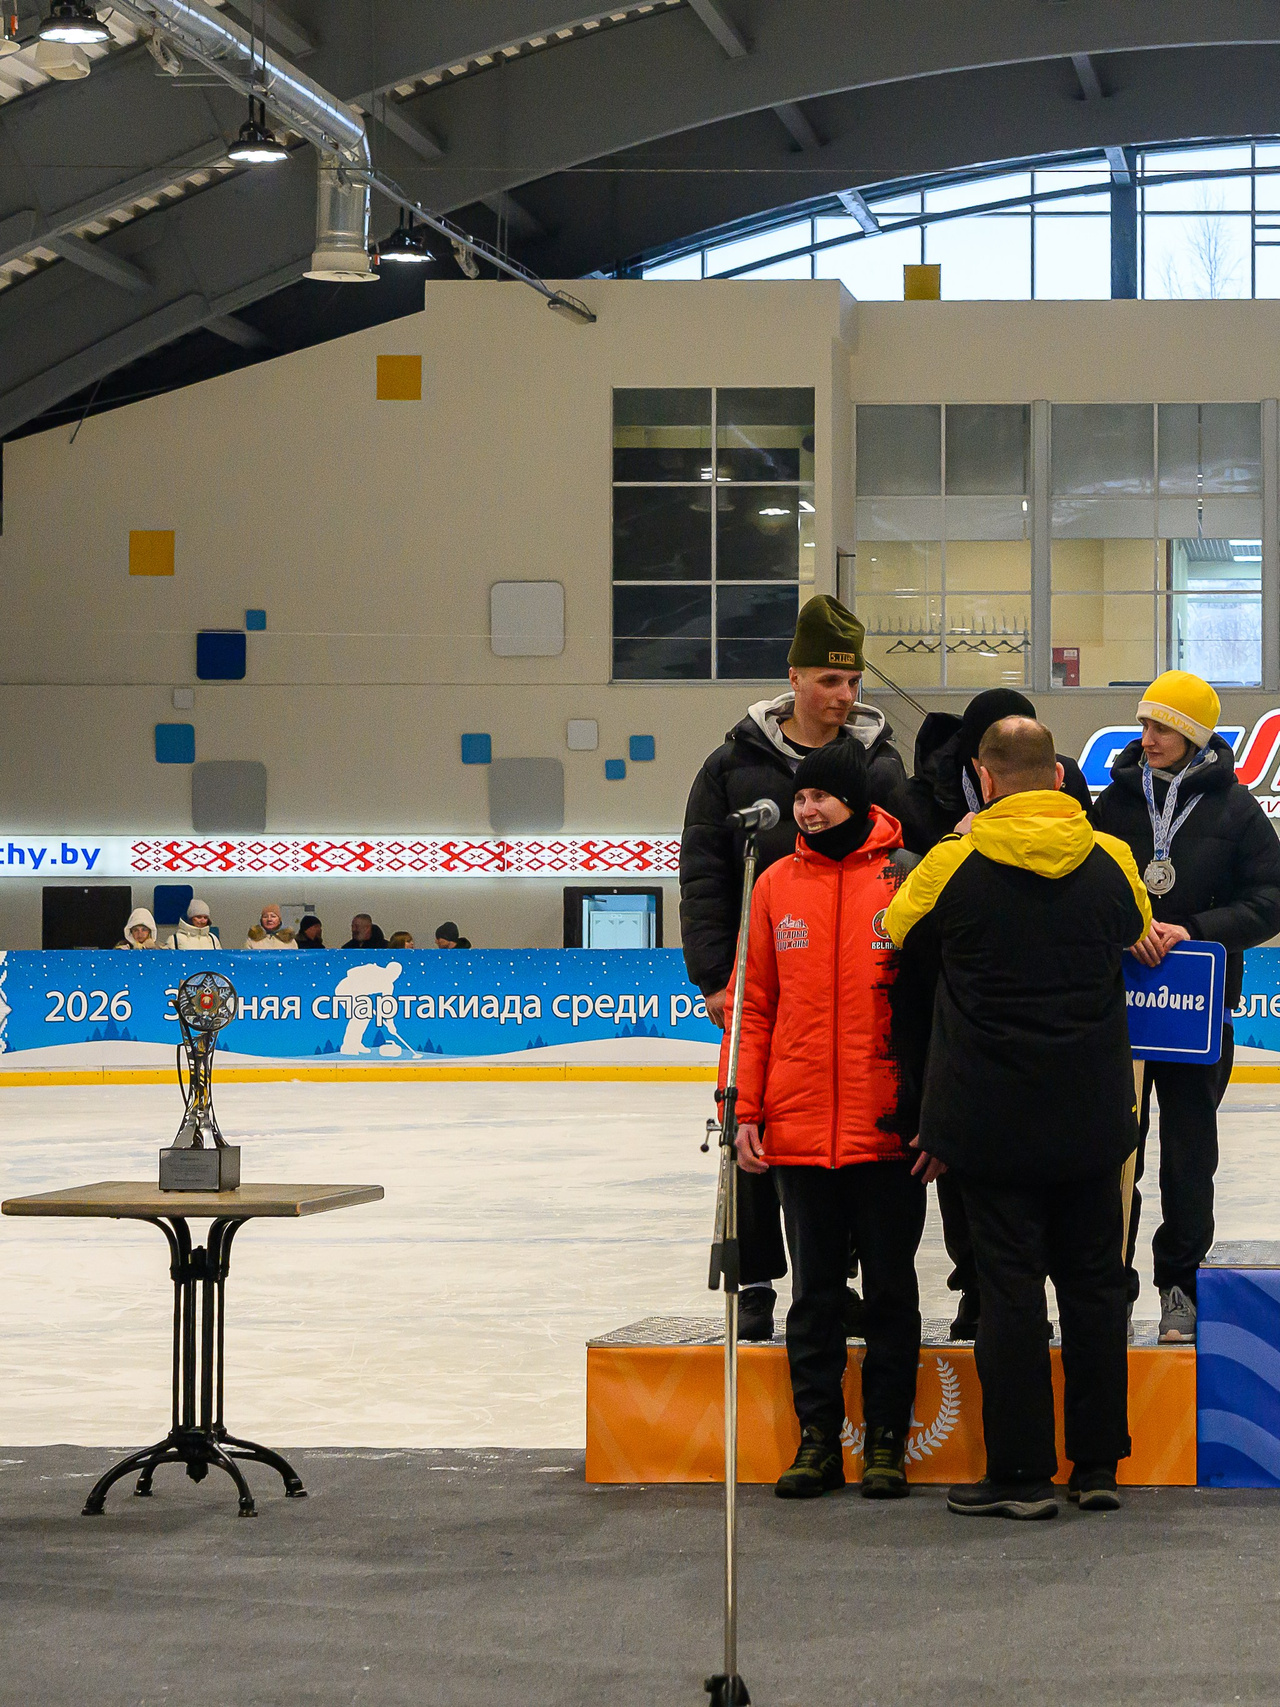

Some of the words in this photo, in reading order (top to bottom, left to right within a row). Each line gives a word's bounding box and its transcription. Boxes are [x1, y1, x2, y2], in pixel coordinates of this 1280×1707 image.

[45, 990, 132, 1022] 2026
[312, 994, 541, 1026] спартакиада
[552, 994, 659, 1026] среди
